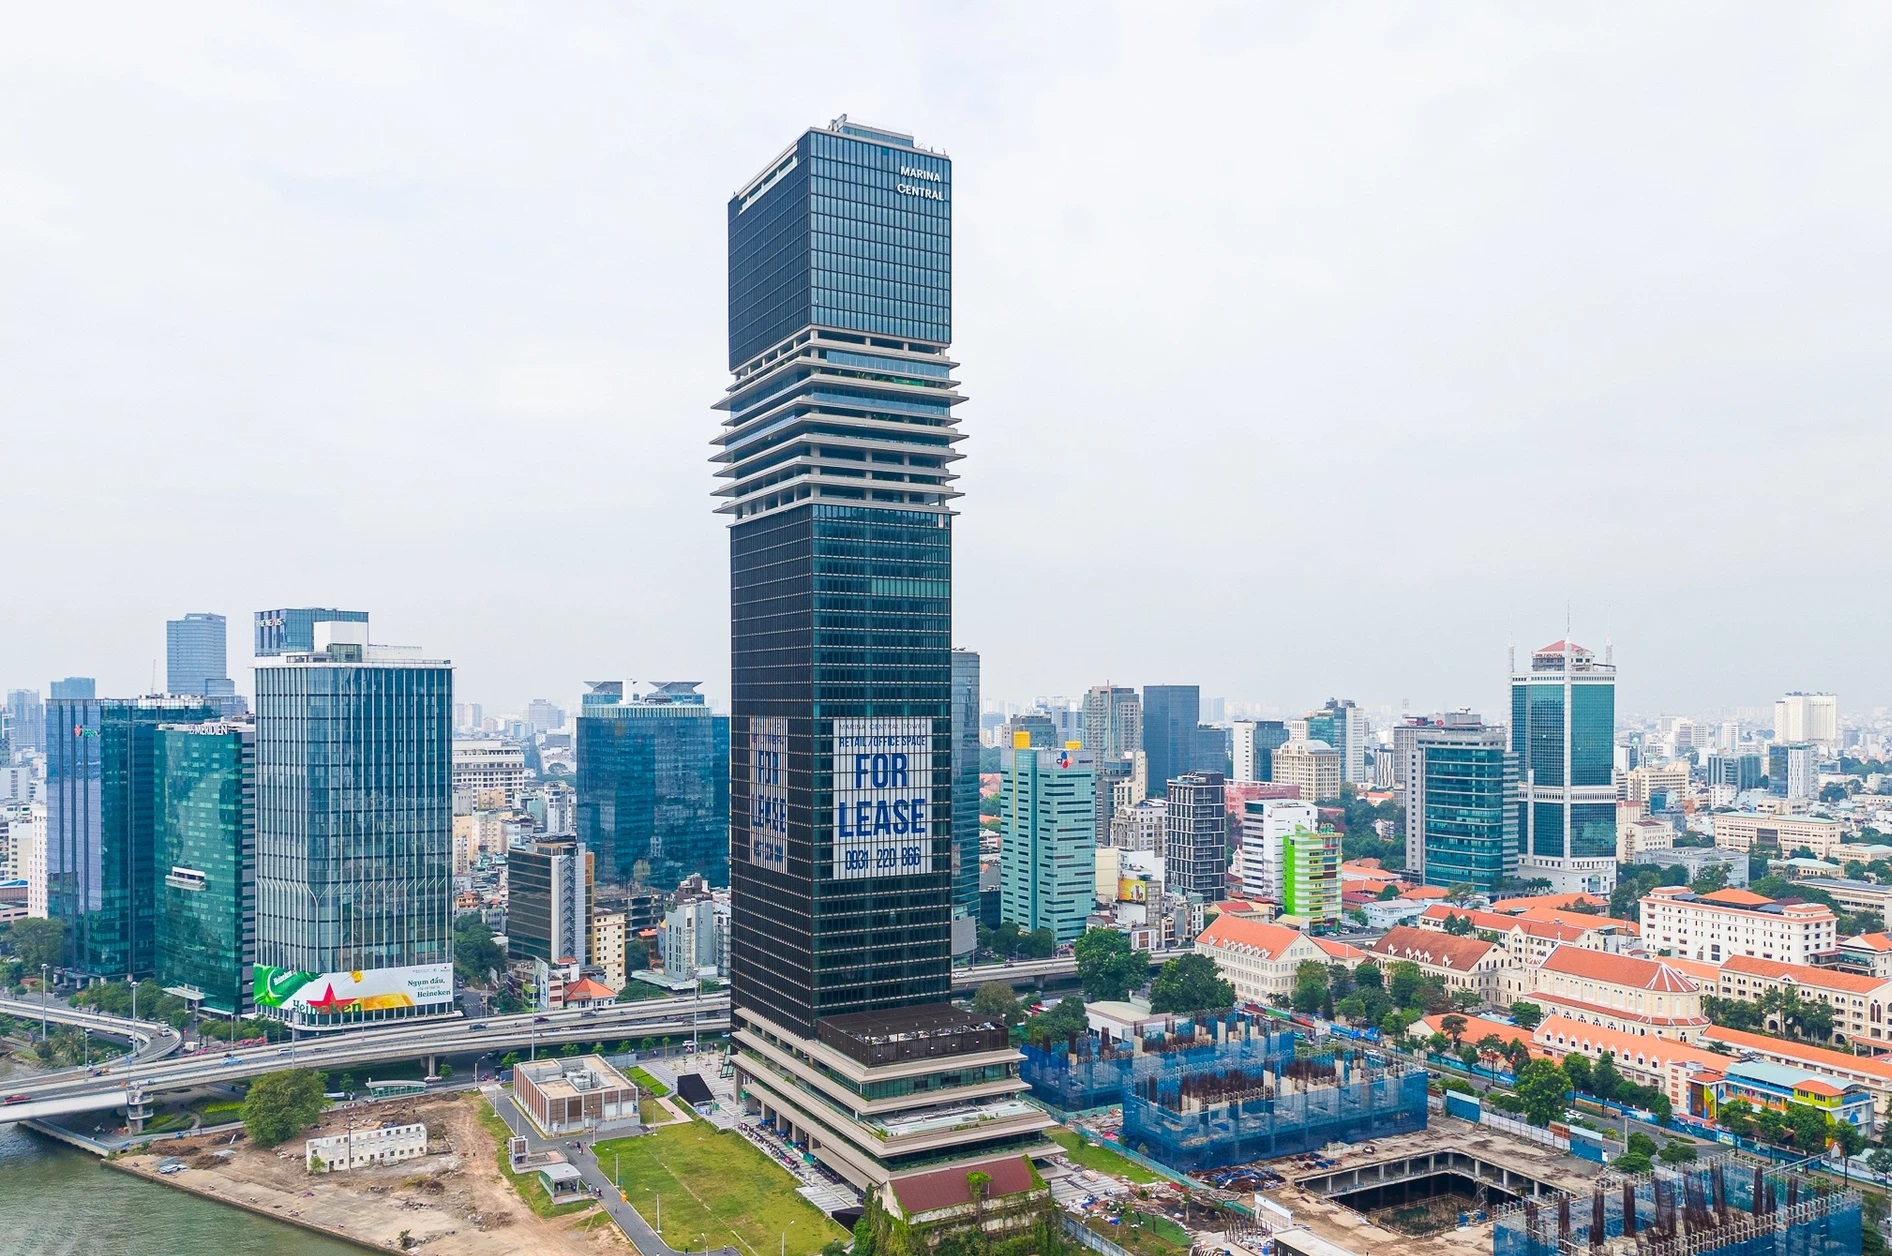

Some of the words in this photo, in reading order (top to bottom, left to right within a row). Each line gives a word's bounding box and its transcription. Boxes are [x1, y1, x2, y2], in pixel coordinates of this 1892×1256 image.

[900, 165, 941, 182] MARINA
[897, 183, 944, 200] CENTRAL
[839, 723, 865, 731] MARINA
[902, 735, 926, 747] SPACE
[855, 753, 908, 789] FOR
[839, 798, 926, 838] LEASE
[417, 989, 450, 998] Heineken
[293, 999, 363, 1015] Heineken
